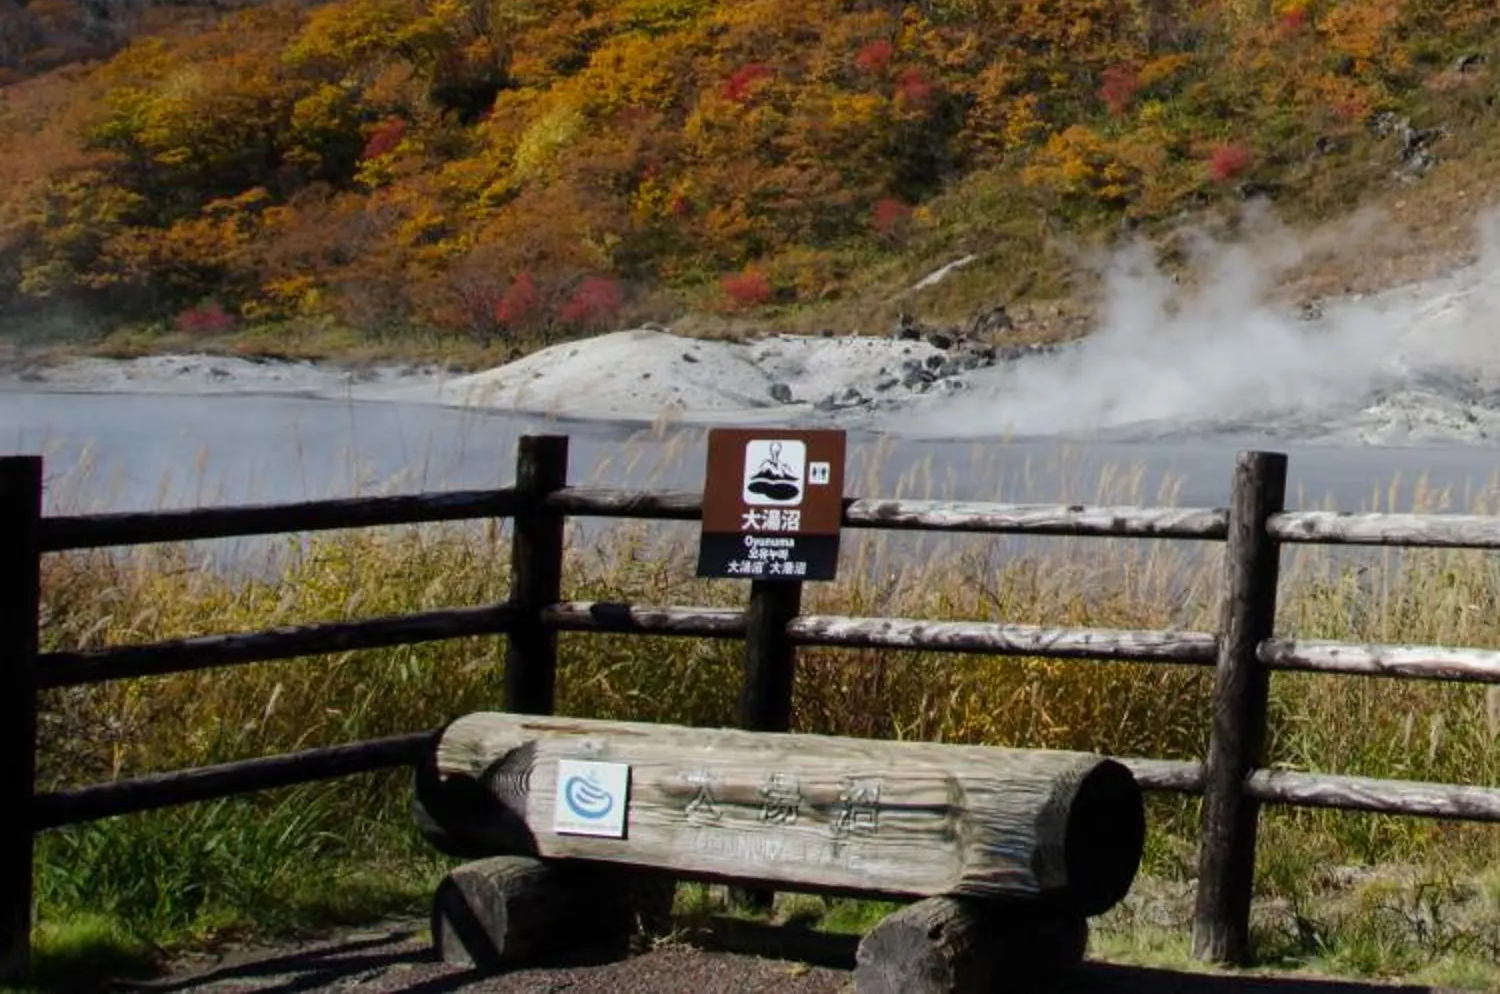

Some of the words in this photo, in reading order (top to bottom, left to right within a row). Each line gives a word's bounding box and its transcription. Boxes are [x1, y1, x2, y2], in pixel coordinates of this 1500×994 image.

[741, 509, 801, 531] 大湯沼
[744, 535, 795, 549] Oyunuma
